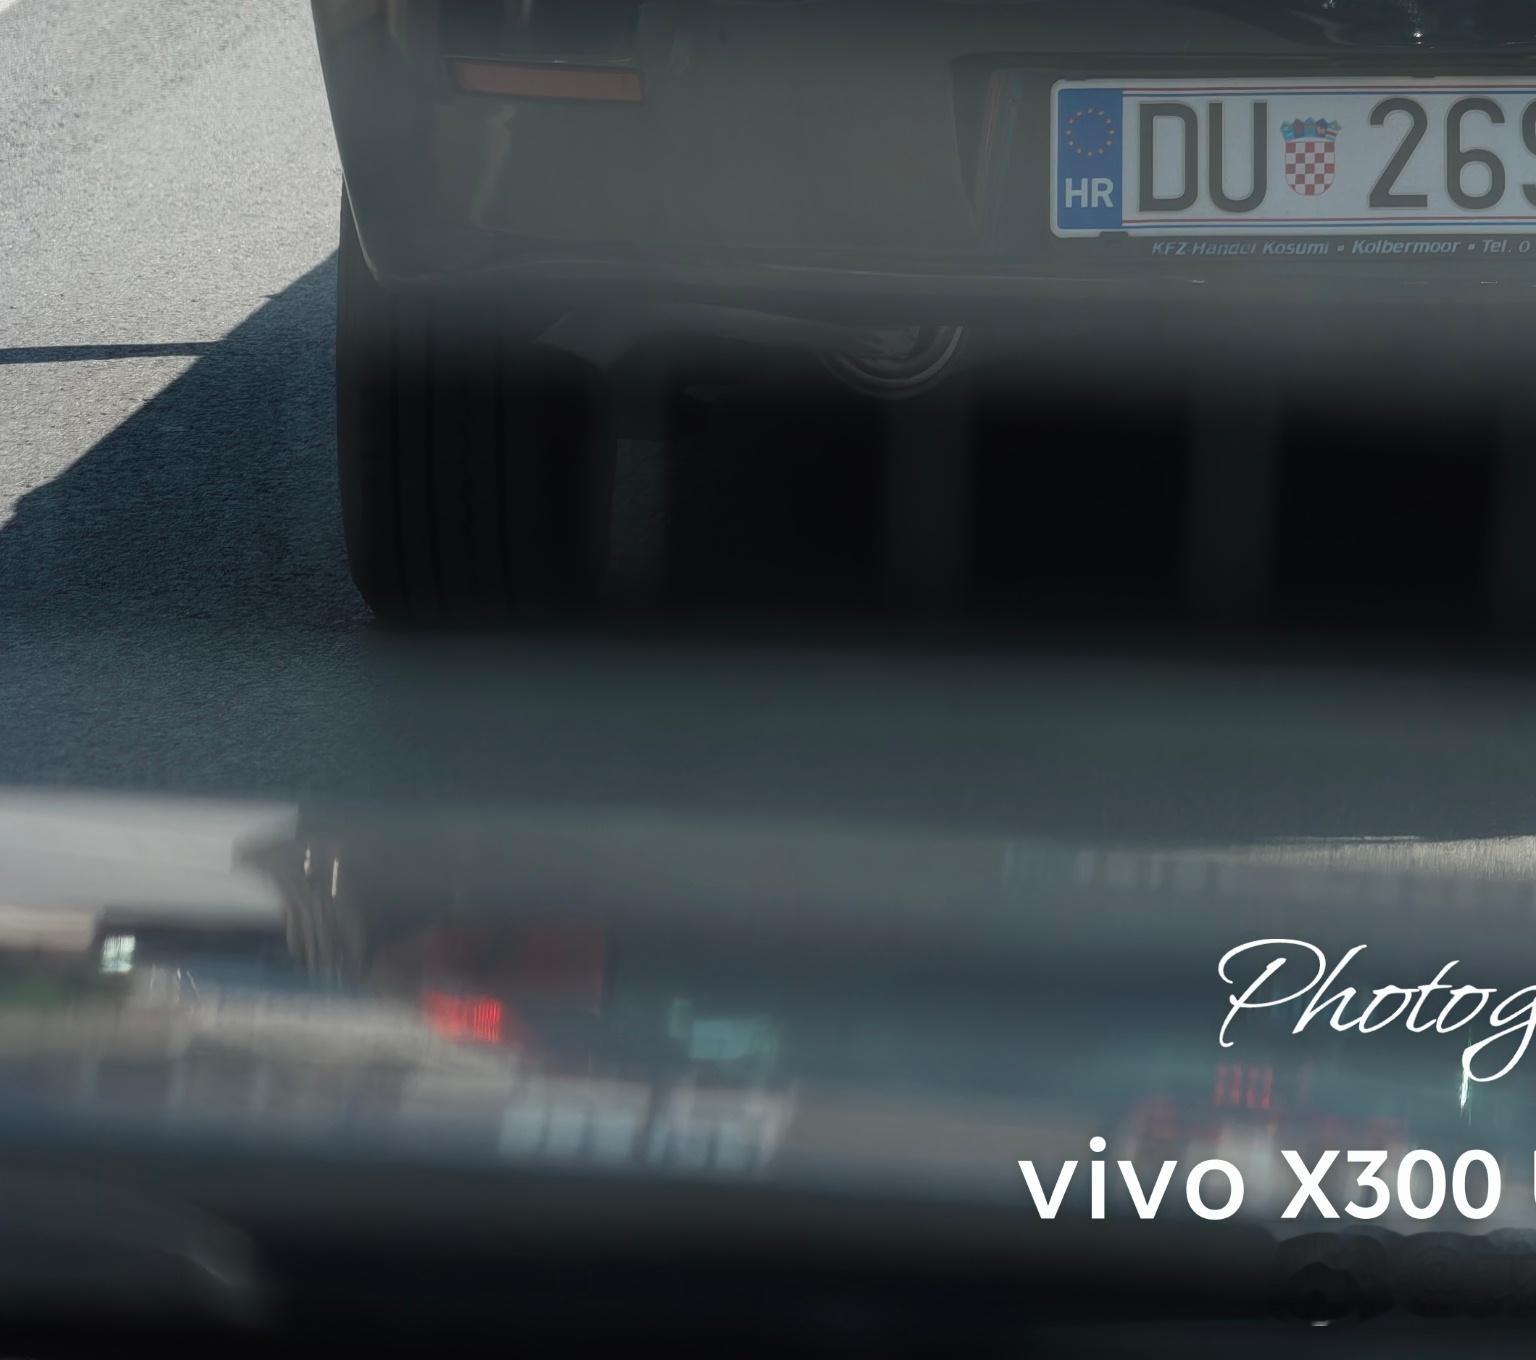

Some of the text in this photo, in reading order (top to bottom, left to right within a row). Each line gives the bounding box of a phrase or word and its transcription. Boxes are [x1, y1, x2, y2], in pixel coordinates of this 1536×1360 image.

[1138, 100, 1268, 213] DU
[1065, 178, 1114, 209] HR
[1262, 240, 1329, 255] Kosumi
[1351, 239, 1461, 255] Kolbermoor
[1482, 239, 1512, 254] Tel.
[1519, 240, 1530, 253] 0
